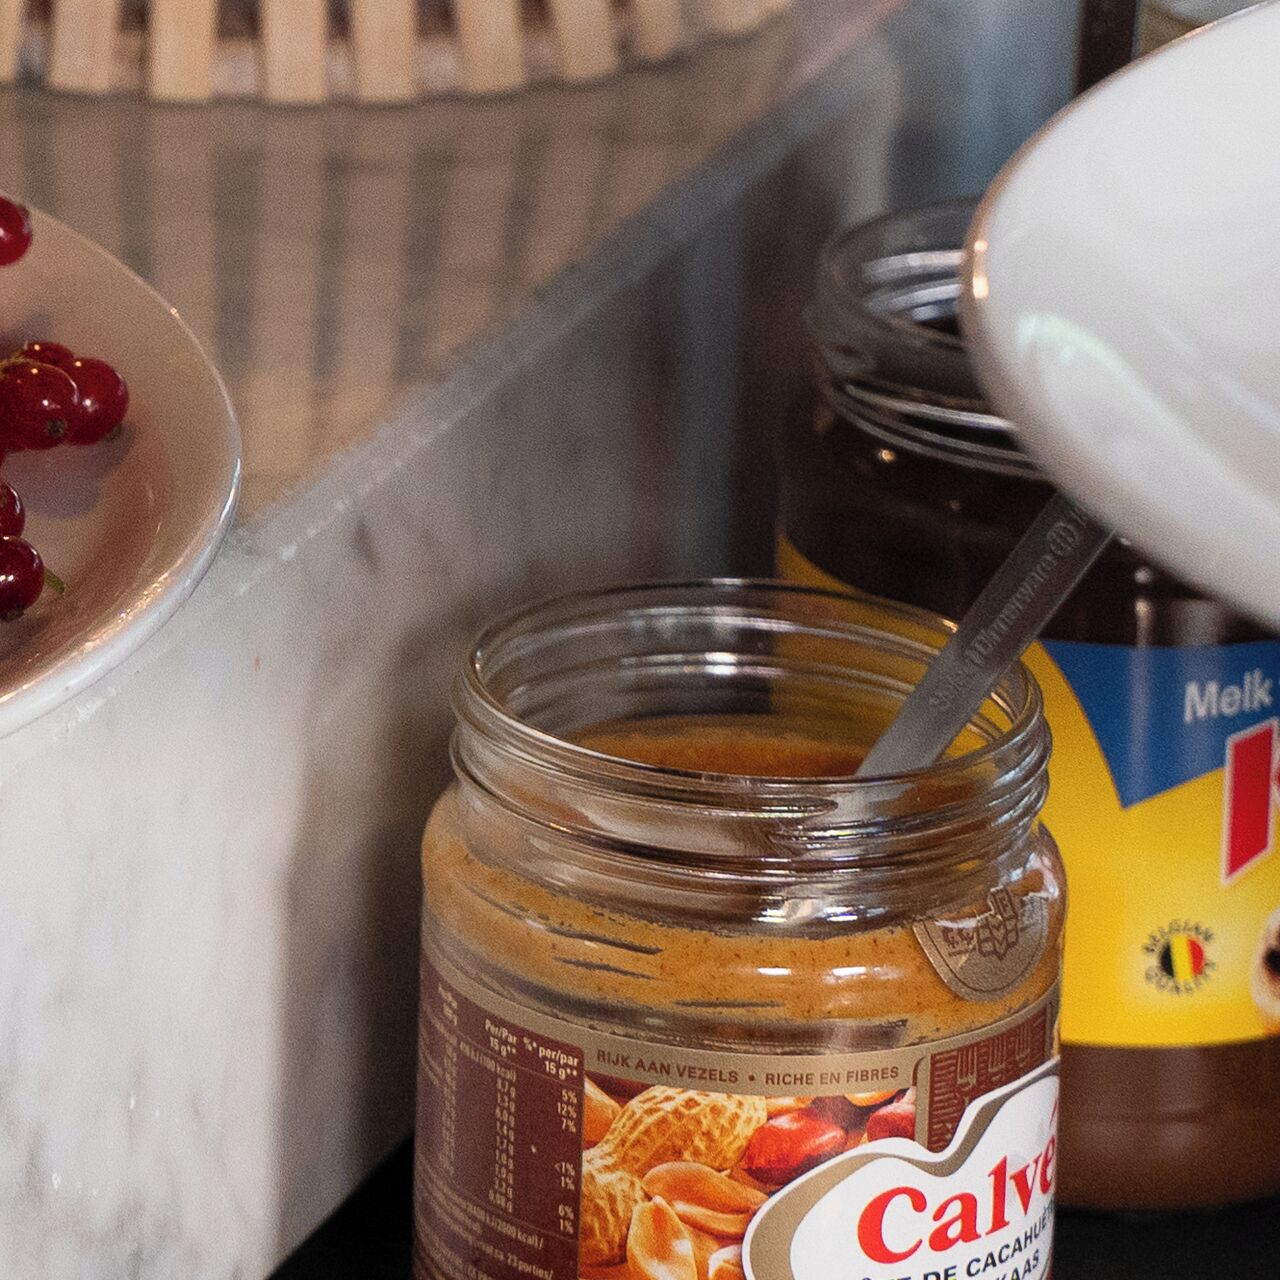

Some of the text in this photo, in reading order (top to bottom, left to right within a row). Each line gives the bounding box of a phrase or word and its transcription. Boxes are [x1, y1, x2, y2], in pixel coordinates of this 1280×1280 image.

[1184, 668, 1273, 724] Melk
[538, 1046, 580, 1067] per/par
[545, 1060, 557, 1075] 15
[596, 1049, 900, 1087] RIJK AAN VEZELS RICHE EN FIBRES
[562, 1088, 577, 1104] 5%
[557, 1101, 577, 1118] 12%
